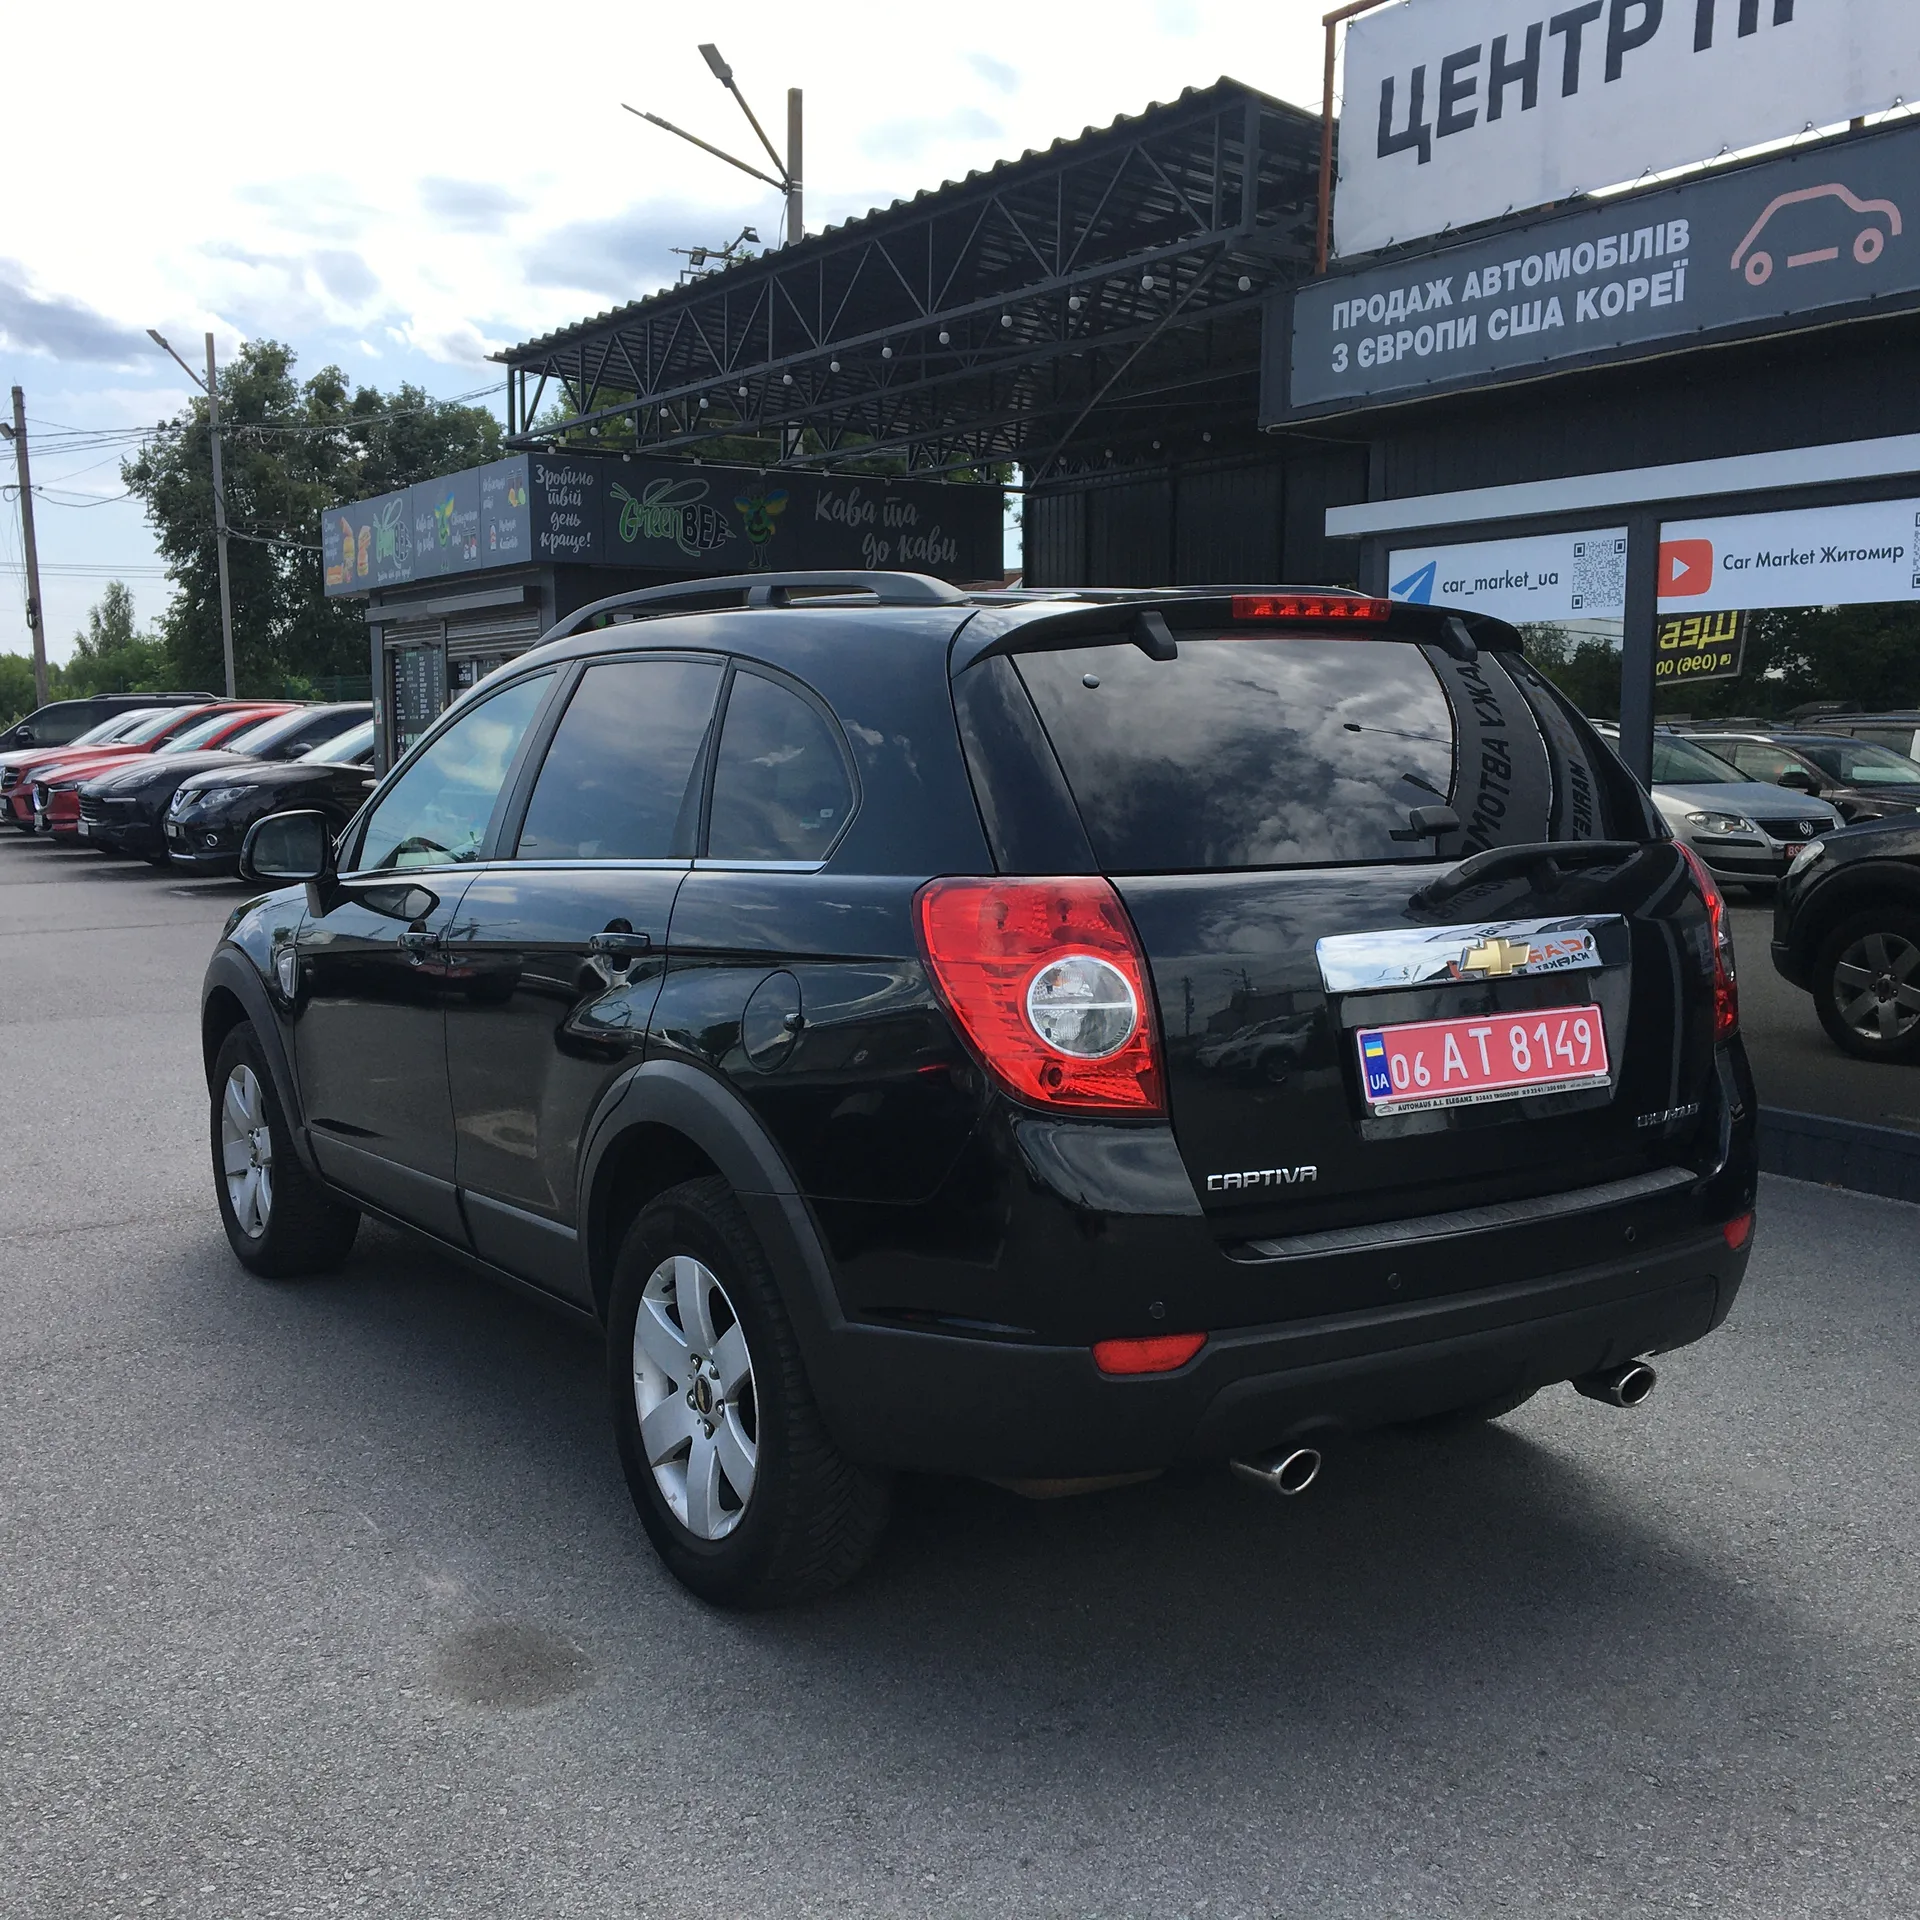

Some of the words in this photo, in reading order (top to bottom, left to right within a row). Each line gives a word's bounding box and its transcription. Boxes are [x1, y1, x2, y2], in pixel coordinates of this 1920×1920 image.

[1377, 0, 1664, 165] ЦЕНТР
[1333, 276, 1453, 331] ПРОДАЖ
[1461, 218, 1690, 302] АВТОМОБІЛІВ
[1332, 343, 1349, 373] З
[1357, 315, 1477, 368] ЄВРОПИ
[1488, 296, 1565, 341] США
[1575, 258, 1690, 323] КОРЕЇ
[535, 464, 594, 491] Зробимо
[547, 486, 582, 507] твій
[815, 486, 877, 527] Кава
[883, 496, 919, 528] та
[550, 510, 582, 532] день
[540, 532, 592, 555] краще!
[862, 532, 891, 569] до
[897, 525, 957, 565] кави
[1723, 554, 1751, 570] Car
[1755, 548, 1816, 568] Market
[1820, 545, 1905, 563] Житомир
[1442, 569, 1559, 595] car_market_ua
[1390, 1051, 1431, 1090] 06
[1443, 1026, 1492, 1082] AT
[1509, 1018, 1591, 1073] 8149
[1370, 1072, 1390, 1091] UA
[1398, 1101, 1431, 1111] AUTOHAUS
[1207, 1165, 1318, 1191] CAPTIVA
